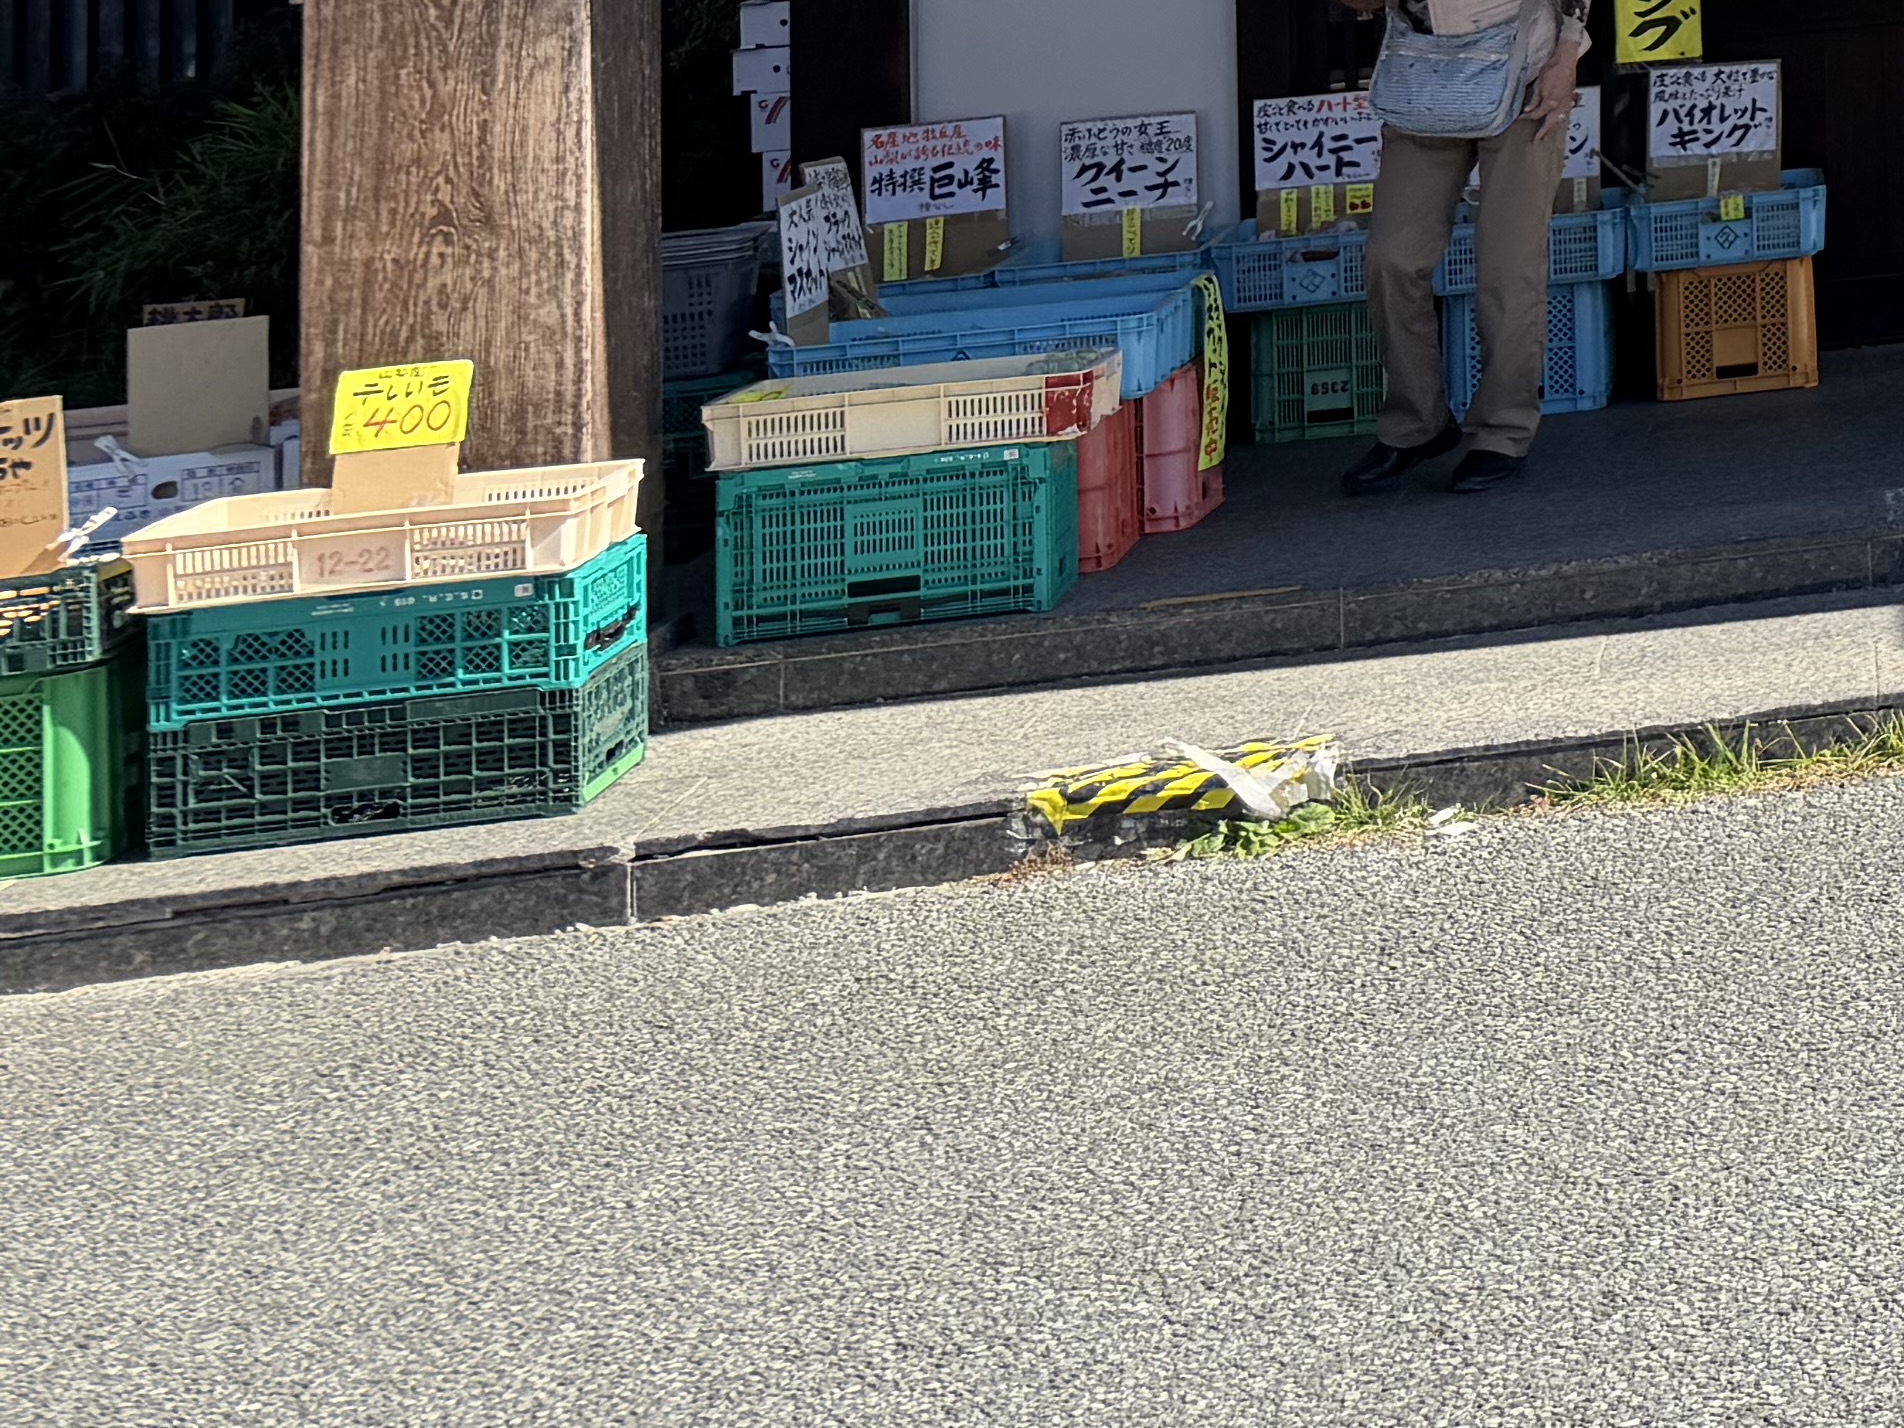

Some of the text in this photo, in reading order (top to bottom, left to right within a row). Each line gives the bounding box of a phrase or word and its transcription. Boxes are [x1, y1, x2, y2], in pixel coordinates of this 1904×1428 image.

[1656, 98, 1768, 128] バイオレット
[1261, 131, 1378, 163] シャイニー
[1668, 123, 1762, 152] キング
[1072, 157, 1181, 187] クイーン
[1279, 155, 1361, 181] ハート
[1081, 177, 1181, 208] ニーナ
[363, 400, 451, 438] 400
[317, 547, 390, 577] 12-22
